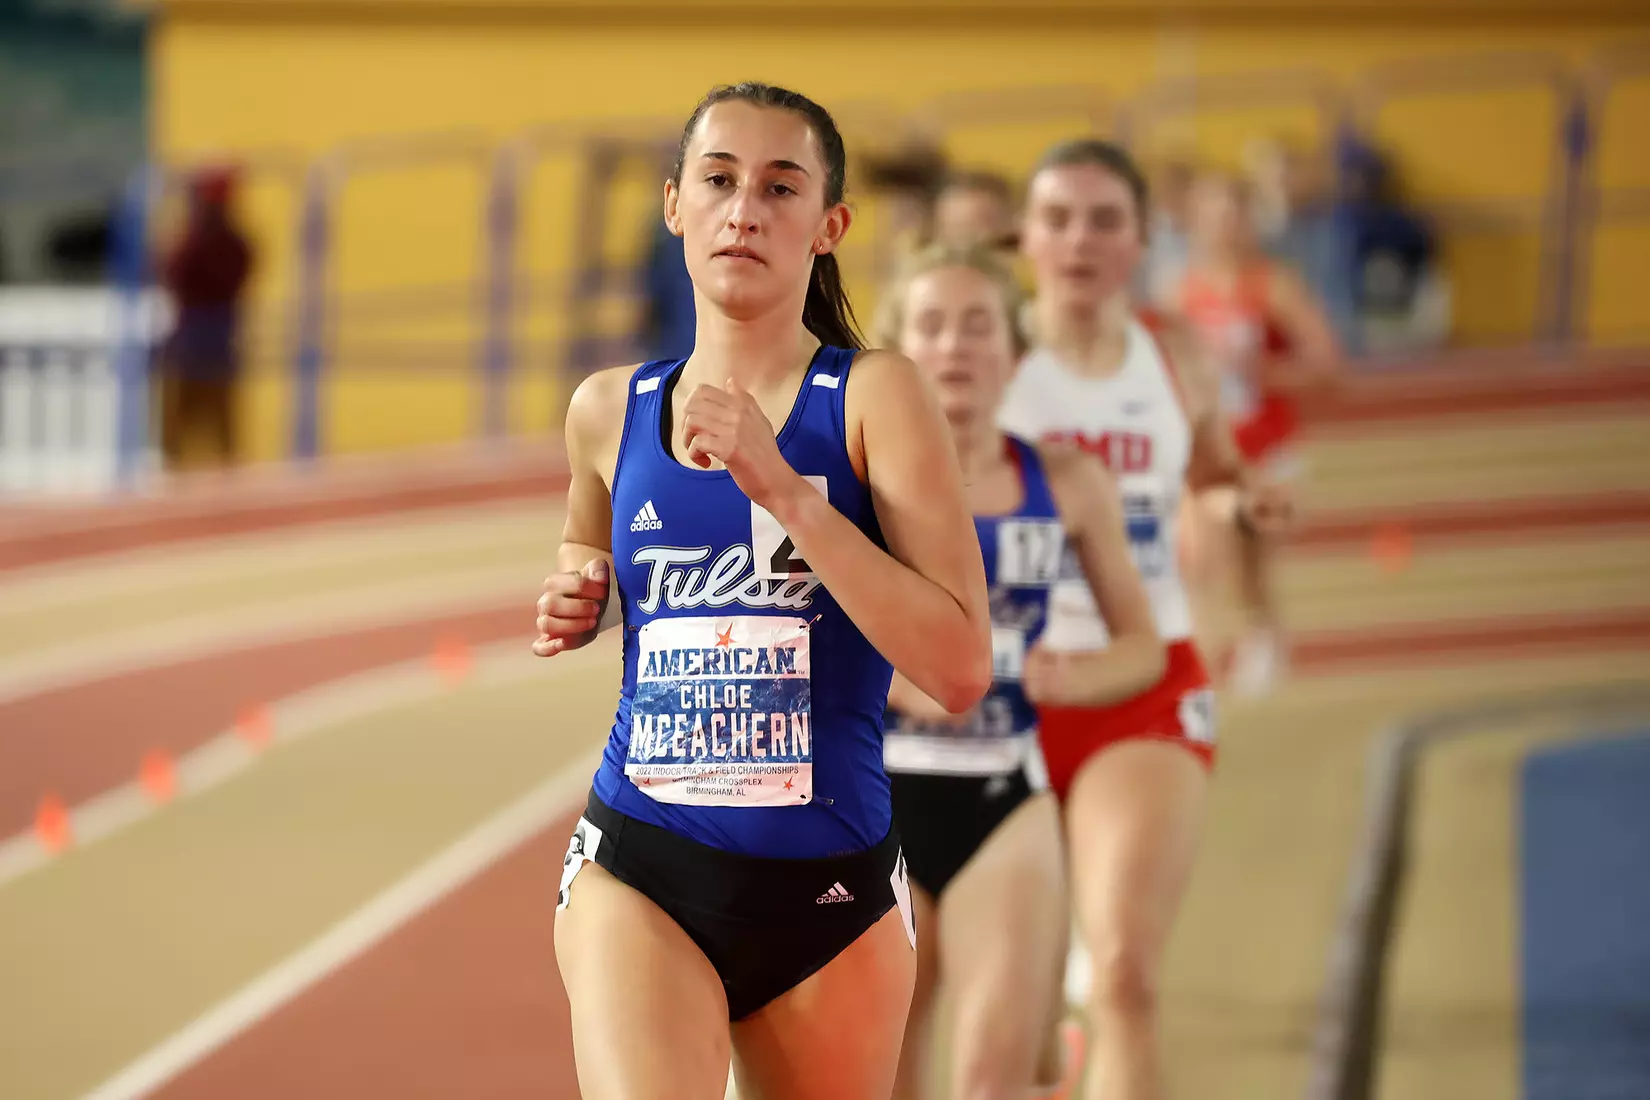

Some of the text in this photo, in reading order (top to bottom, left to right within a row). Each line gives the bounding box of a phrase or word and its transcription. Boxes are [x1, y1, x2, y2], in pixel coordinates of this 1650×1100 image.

[630, 518, 663, 532] adidas
[632, 543, 824, 615] Tulsa
[642, 647, 797, 678] AMERICAN
[680, 684, 752, 709] CHLOE
[629, 712, 810, 758] MCEACHERN
[635, 766, 651, 776] 2022
[682, 766, 707, 775] TRACK
[709, 766, 714, 774] &
[715, 766, 736, 775] FIELD
[737, 765, 799, 775] CHAMPIONSHIPS
[718, 777, 763, 786] CROSSPLEX
[686, 786, 746, 797] BIRMINGHAM, AL
[816, 894, 855, 904] adidas
